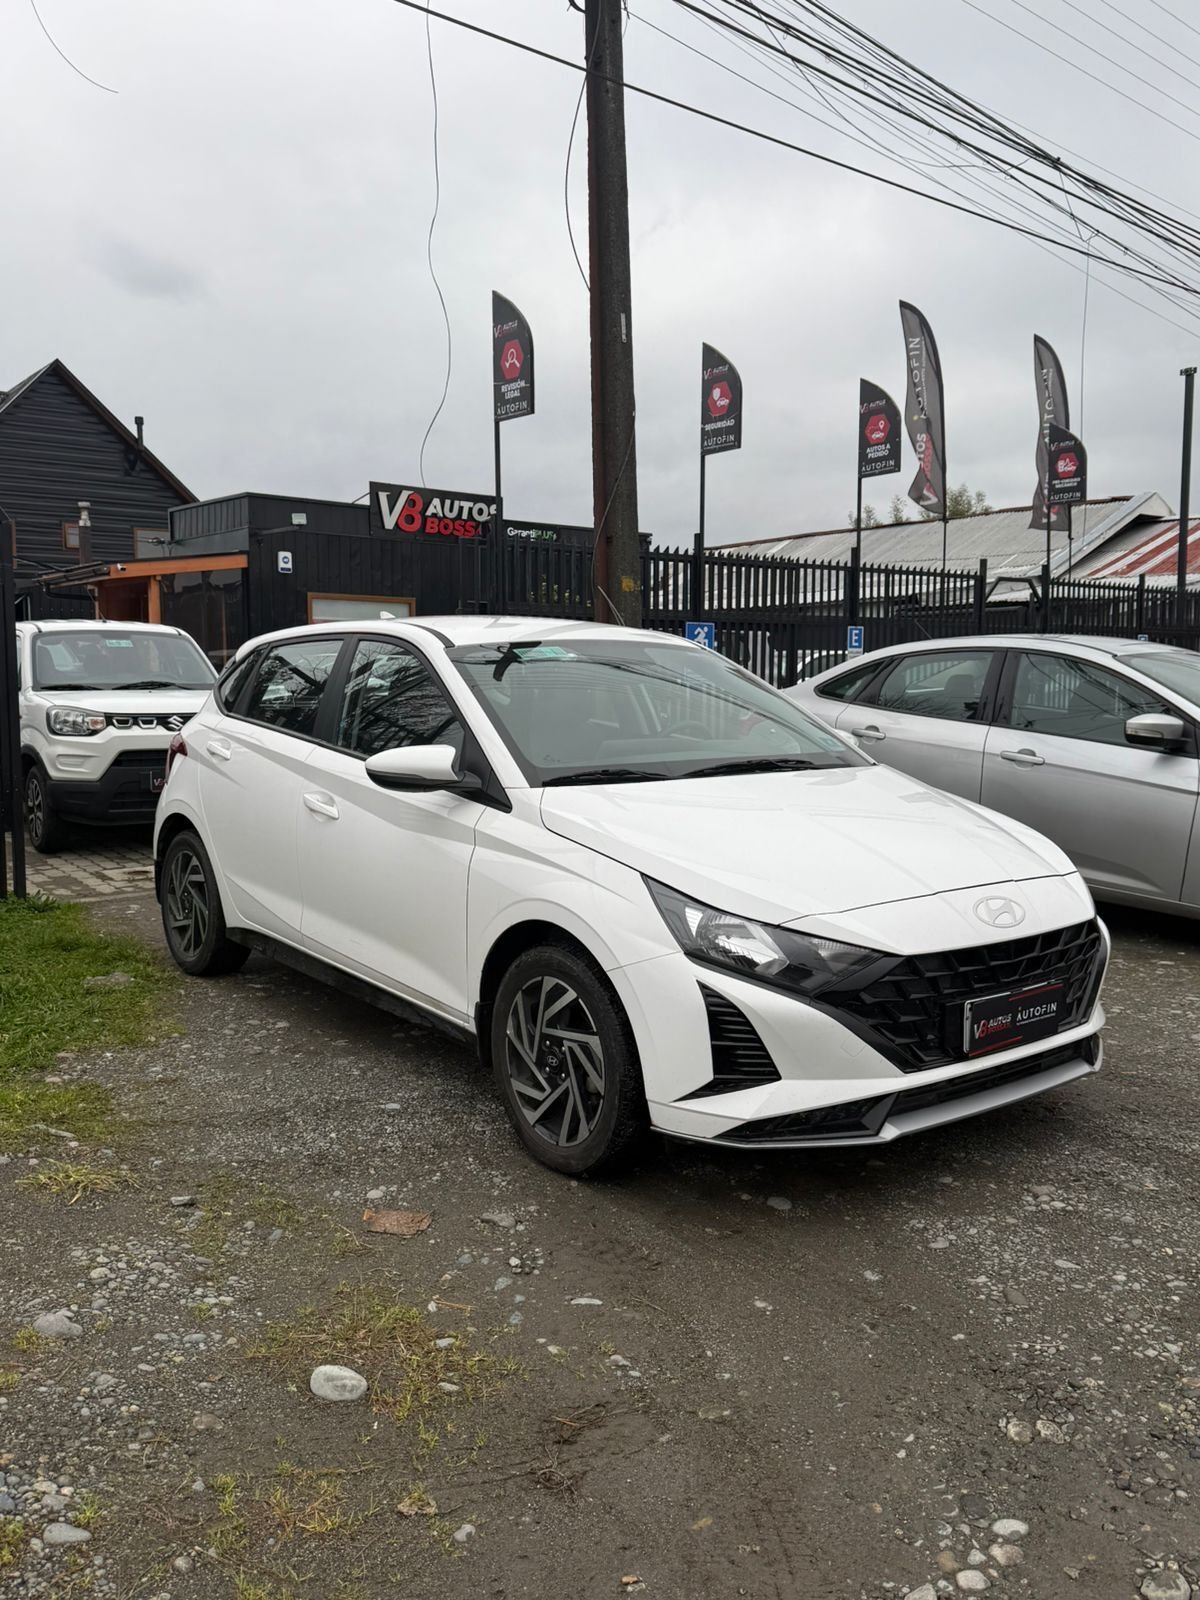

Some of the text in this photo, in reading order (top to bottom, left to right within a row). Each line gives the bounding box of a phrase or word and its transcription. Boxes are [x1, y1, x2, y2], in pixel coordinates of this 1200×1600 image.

[497, 400, 528, 415] AUTOFIN
[704, 419, 735, 431] SEGURIDAD
[703, 434, 735, 447] AUTOFIN
[866, 445, 885, 454] AUTOS
[861, 460, 895, 472] AUTOFIN
[1050, 492, 1081, 501] AUTOFIN
[378, 490, 423, 532] V8
[852, 629, 860, 647] E
[974, 1020, 988, 1039] V8
[988, 1013, 1012, 1028] AUTOS
[1016, 1002, 1058, 1021] AUTOFIN
